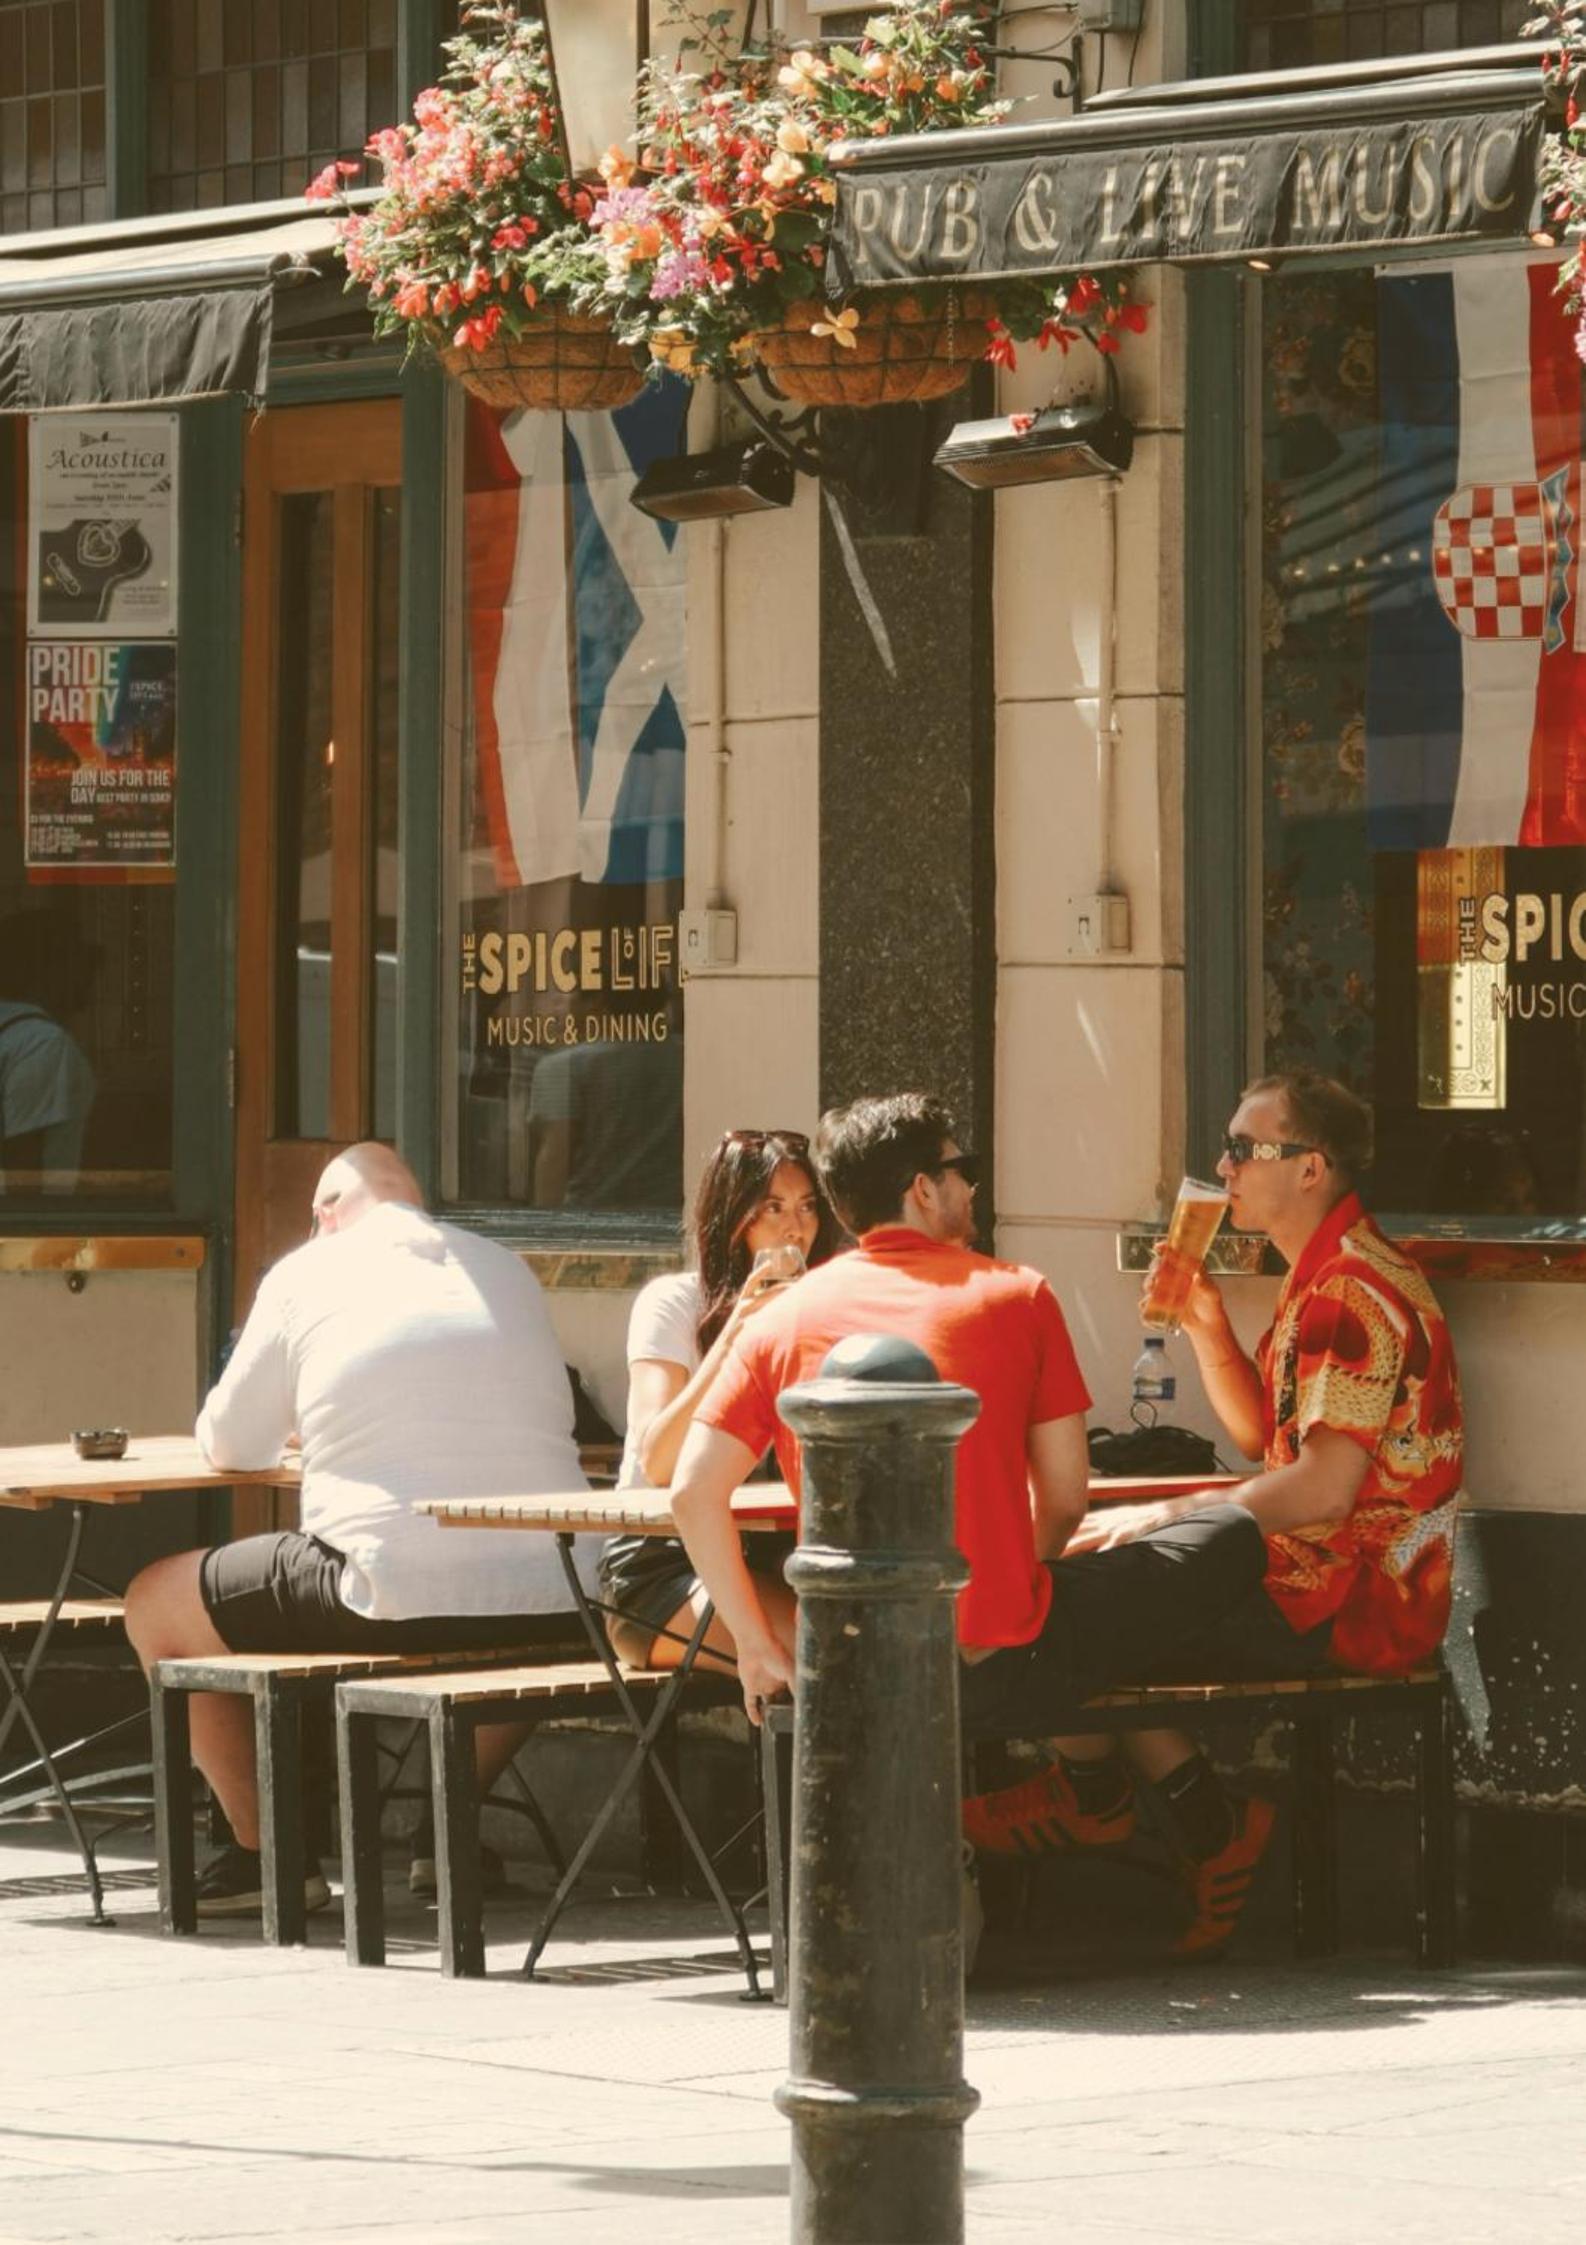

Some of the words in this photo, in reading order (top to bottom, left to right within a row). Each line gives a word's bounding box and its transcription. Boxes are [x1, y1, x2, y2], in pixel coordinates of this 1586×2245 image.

[853, 178, 979, 264] PUB
[1015, 171, 1059, 252] &
[1100, 152, 1246, 242] LIVE
[1292, 129, 1516, 229] MUSIC
[46, 450, 165, 469] Acoustica
[32, 646, 120, 686] PRIDE
[32, 687, 120, 723] PARTY
[72, 769, 97, 786] JOIN
[100, 769, 116, 786] US
[119, 769, 143, 786] FOR
[146, 769, 170, 786] THE
[72, 787, 96, 803] DAY
[1460, 898, 1476, 966] THE
[1481, 893, 1586, 964] SPIC
[463, 934, 476, 994] THE
[479, 930, 602, 994] SPICE
[611, 926, 687, 990] LIF
[1491, 983, 1586, 1021] MUSIC
[487, 1015, 557, 1046] MUSIC
[563, 1014, 578, 1045] &
[586, 1012, 667, 1043] DINING
